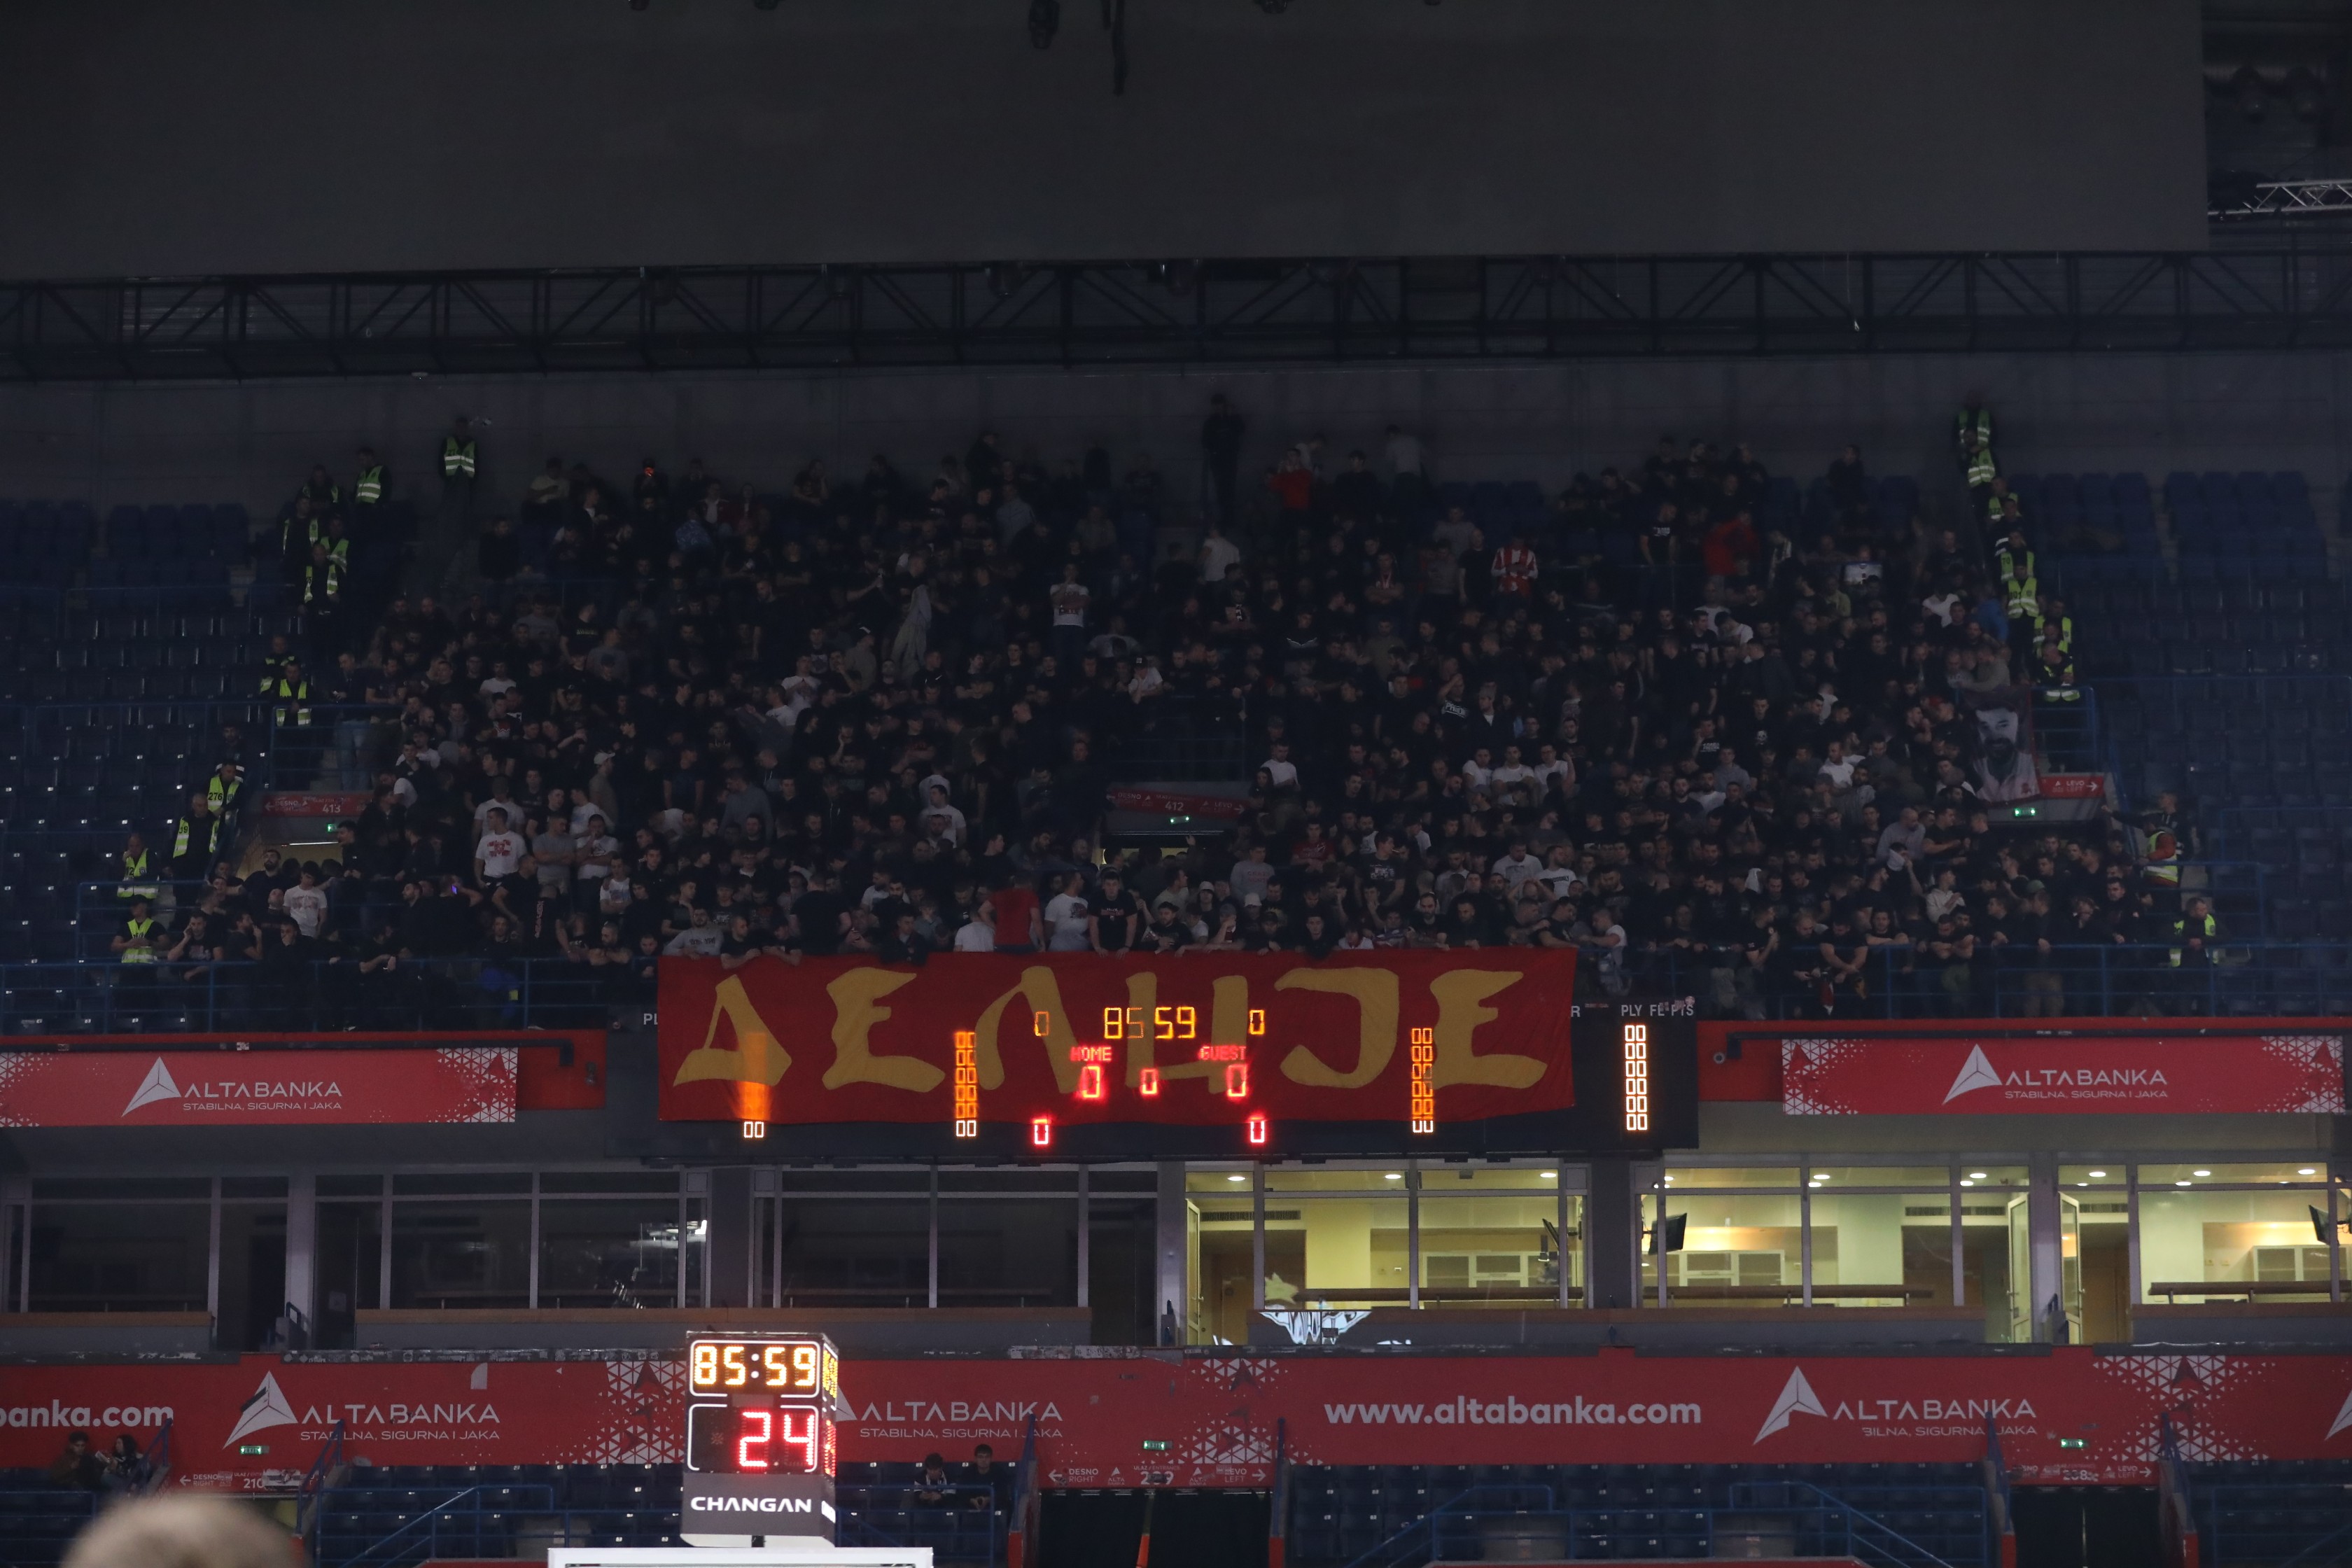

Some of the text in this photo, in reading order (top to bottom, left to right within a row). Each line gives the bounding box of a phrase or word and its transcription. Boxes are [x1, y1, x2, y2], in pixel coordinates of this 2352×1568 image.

[208, 792, 223, 802] 276
[322, 804, 341, 813] 413
[1165, 801, 1184, 811] 412
[1621, 1004, 1642, 1016] PLY
[1671, 1004, 1694, 1016] PTS
[643, 1013, 658, 1025] PL
[1035, 1011, 1049, 1036] 0
[1249, 1009, 1265, 1035] 0
[1412, 1028, 1433, 1044] 00
[1625, 1025, 1646, 1042] 00
[1070, 1046, 1112, 1061] HOME
[1199, 1046, 1246, 1060] GUEST
[1412, 1046, 1433, 1062] 00
[1625, 1042, 1646, 1059] 00
[1625, 1060, 1646, 1077] 00
[1081, 1065, 1100, 1098] 0
[1142, 1068, 1157, 1094] 0
[1227, 1064, 1247, 1097] 0
[2005, 1070, 2167, 1085] ALTABANKA
[184, 1082, 342, 1098] ALTABANKA
[1625, 1078, 1647, 1095] 00
[2005, 1091, 2068, 1099] STABILNA,
[1626, 1096, 1647, 1113] 00
[744, 1121, 764, 1138] 00
[955, 1120, 976, 1137] 00
[1250, 1116, 1265, 1142] 0
[1626, 1114, 1648, 1130] 00
[1034, 1119, 1049, 1144] 0
[694, 1346, 816, 1386] 85:59
[0, 1399, 174, 1427] anka.com
[302, 1404, 500, 1424] ALTABANKA
[861, 1401, 1063, 1421] ALTABANKA
[1324, 1395, 1701, 1424] www.altabanka.com
[1833, 1399, 2037, 1420] ALTABANKA
[300, 1432, 377, 1441] STABLNA,
[381, 1431, 449, 1440] SIGURNA
[459, 1431, 500, 1439] JAKA
[739, 1411, 815, 1467] 24
[860, 1428, 938, 1438] STABILNA,
[942, 1428, 1011, 1437] SIGURNA
[1915, 1427, 1985, 1436] SIGURNA
[1995, 1425, 2038, 1435] JAKA
[690, 1497, 812, 1513] CHANGAN
